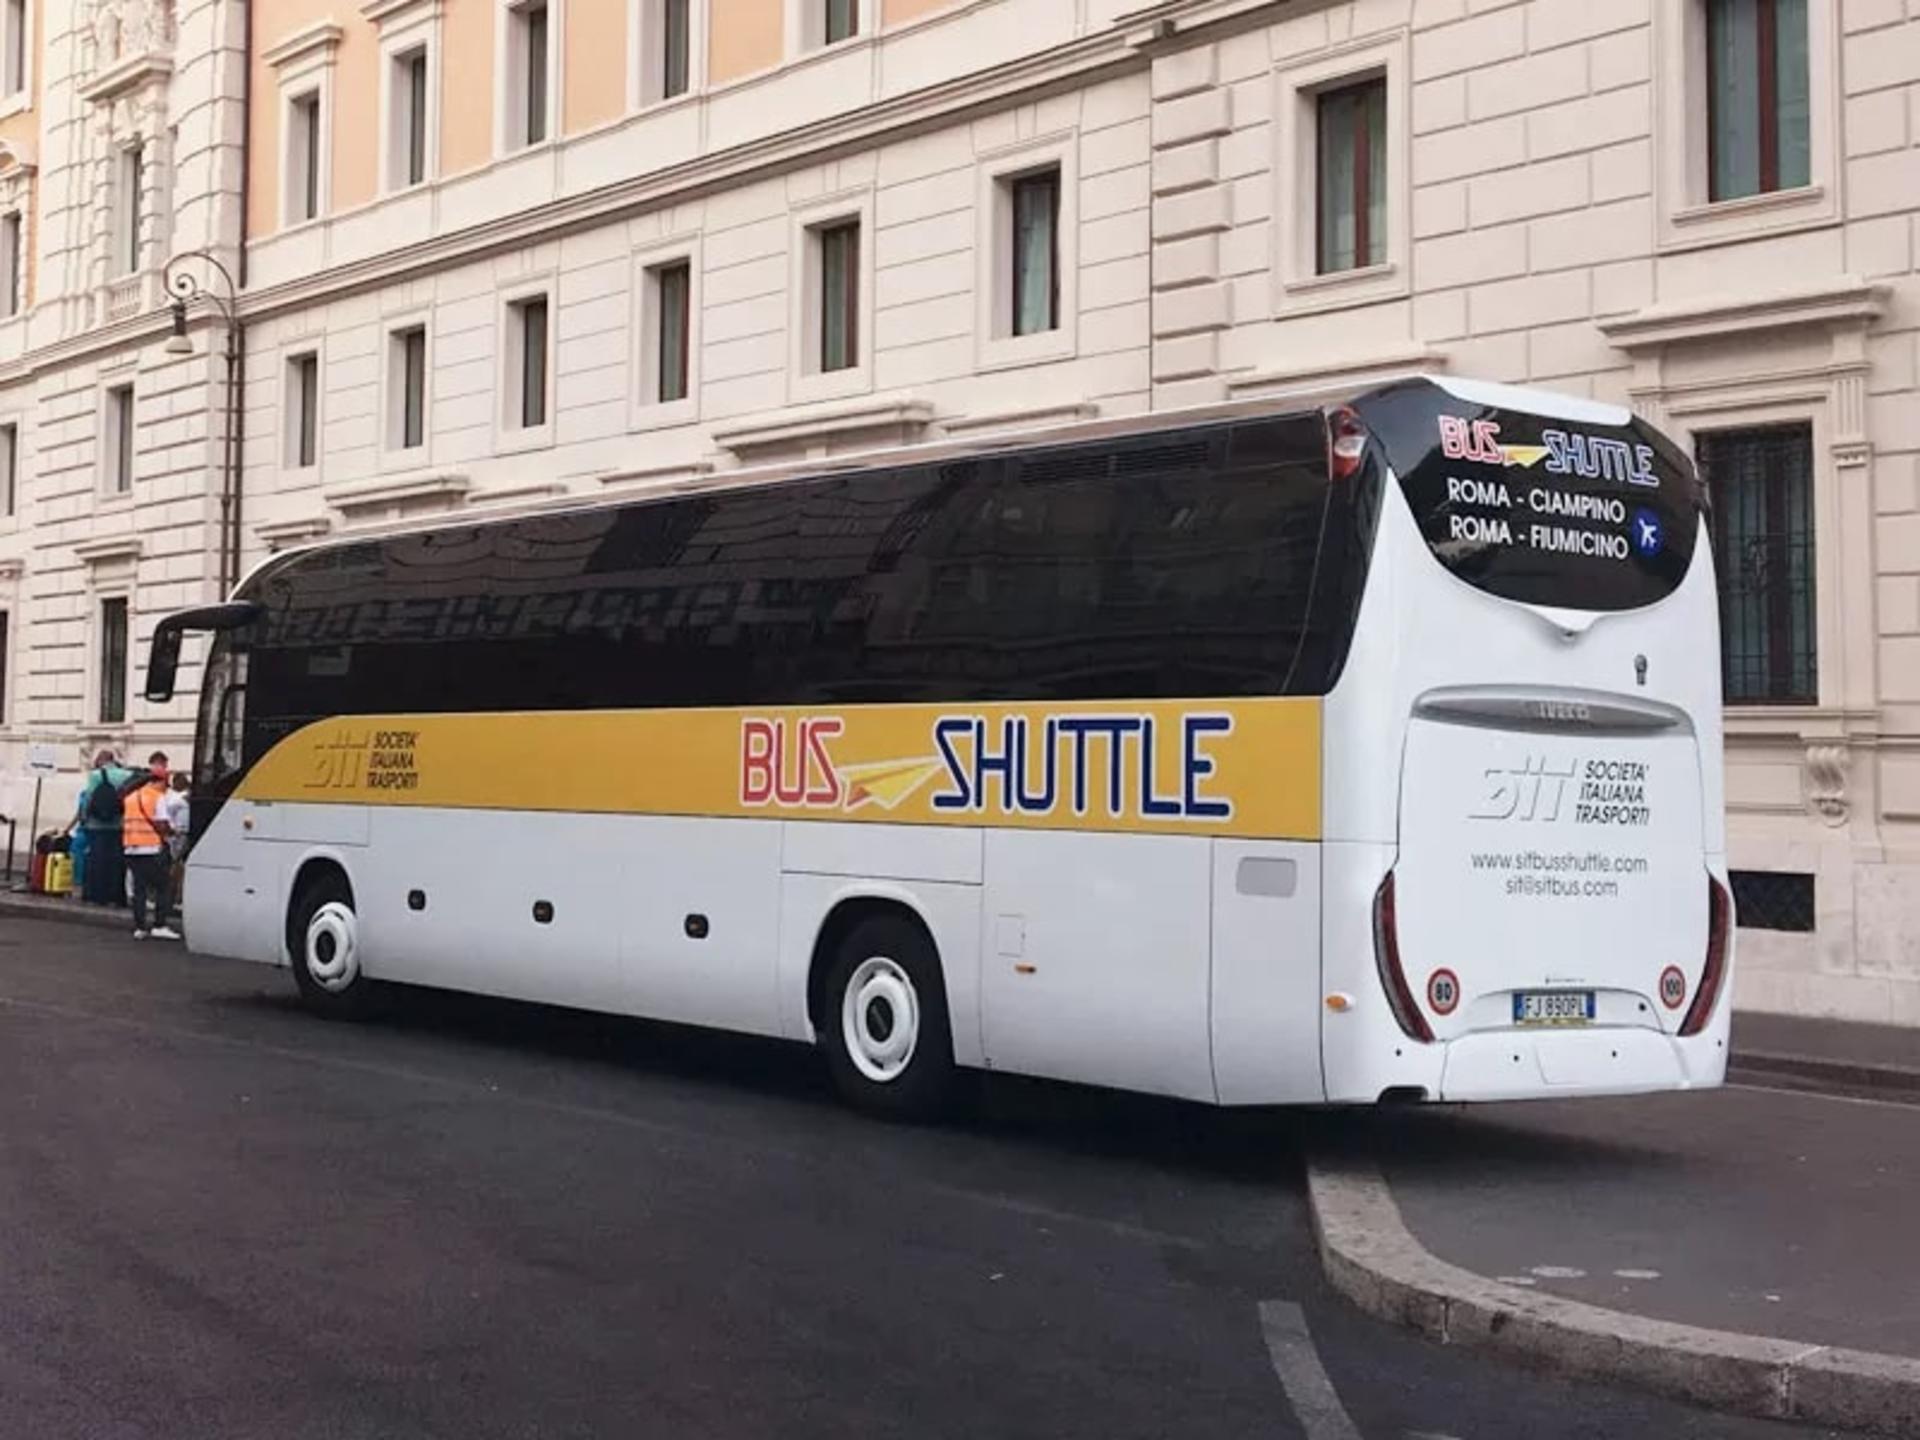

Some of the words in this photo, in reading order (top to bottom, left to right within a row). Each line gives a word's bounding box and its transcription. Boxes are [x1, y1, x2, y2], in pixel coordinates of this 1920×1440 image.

[1438, 414, 1503, 464] BUS
[1543, 429, 1660, 488] SHUTTLE
[1447, 478, 1512, 508] ROMA
[1529, 488, 1626, 523] CIAMPINO
[1450, 515, 1513, 545] ROMA
[1530, 524, 1629, 560] FIUMICINO
[740, 716, 843, 807] BUS
[931, 713, 1234, 820] SHUTTLE
[1578, 782, 1645, 803] ITALIANA
[1575, 803, 1650, 826] TRASPORTI
[1471, 852, 1648, 873] www.sitbusshuttle.com
[1506, 875, 1619, 897] sit@sitbus.com
